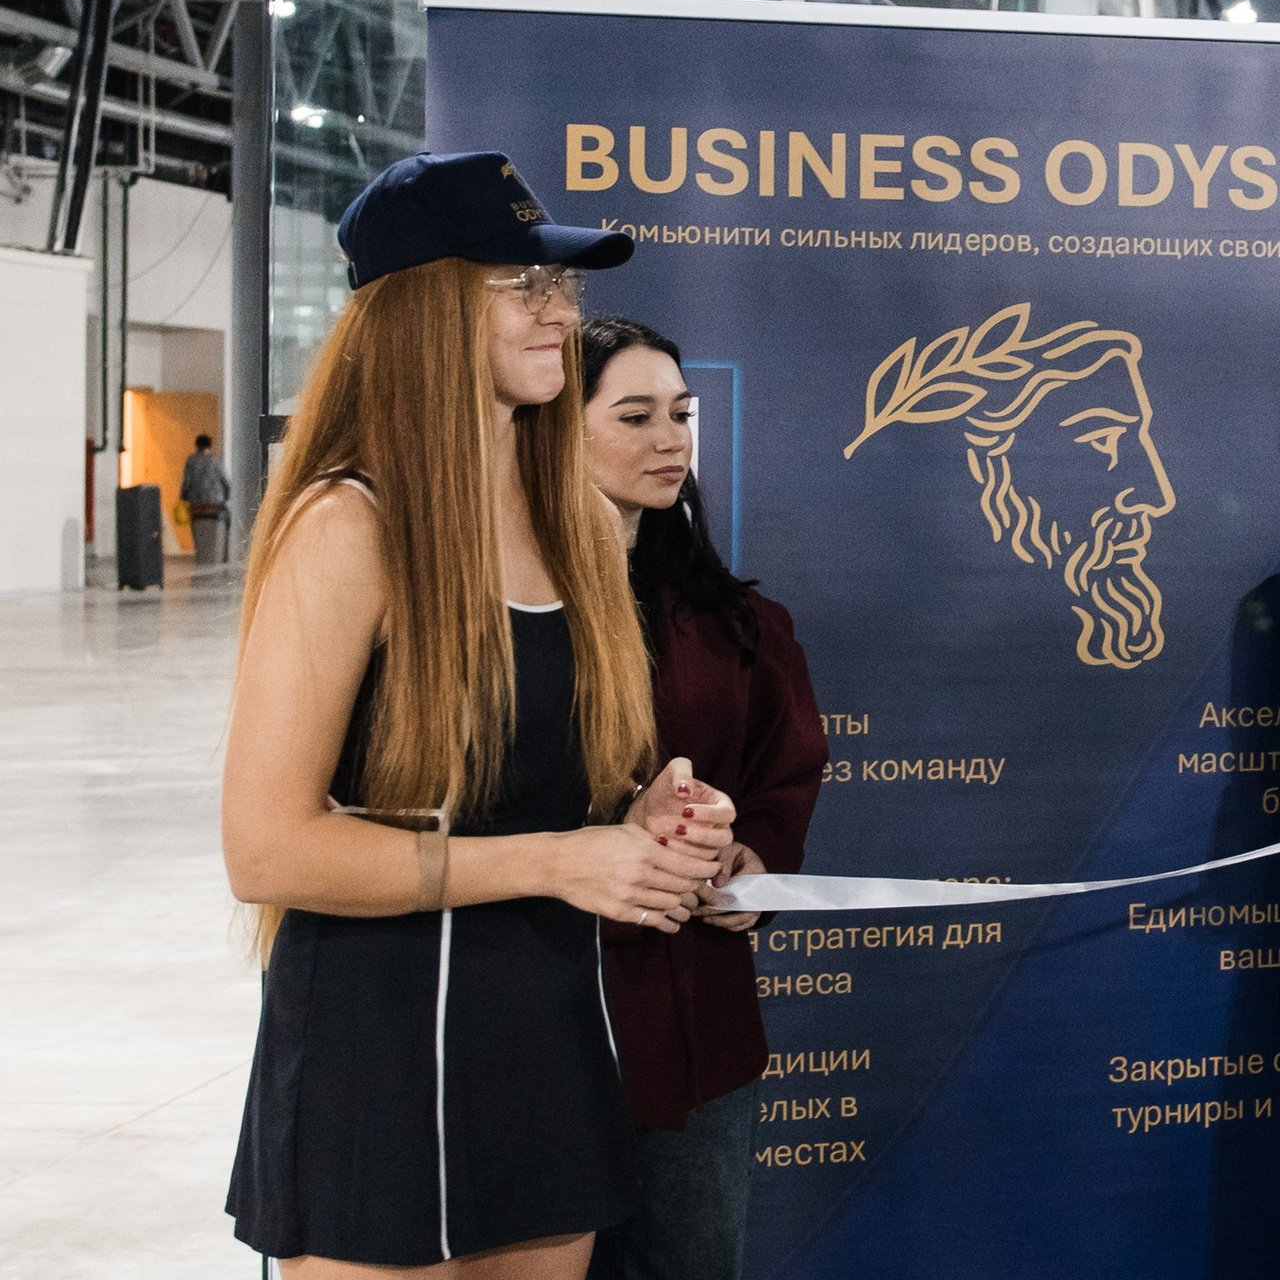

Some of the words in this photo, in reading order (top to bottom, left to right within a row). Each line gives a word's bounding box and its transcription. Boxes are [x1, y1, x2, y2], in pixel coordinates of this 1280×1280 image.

[565, 123, 1021, 204] BUSINESS
[601, 218, 771, 246] Комьюнити
[779, 227, 902, 250] сильных
[910, 231, 1041, 257] лидеров,
[1047, 233, 1212, 260] создающих
[861, 756, 1005, 786] команду
[768, 924, 934, 957] стратегия
[941, 922, 1002, 950] для
[761, 1048, 871, 1081] диции
[1108, 1053, 1264, 1086] Закрытые
[840, 1096, 858, 1118] в
[1112, 1100, 1244, 1134] турниры
[1254, 1098, 1273, 1118] и
[755, 1140, 866, 1167] местах
